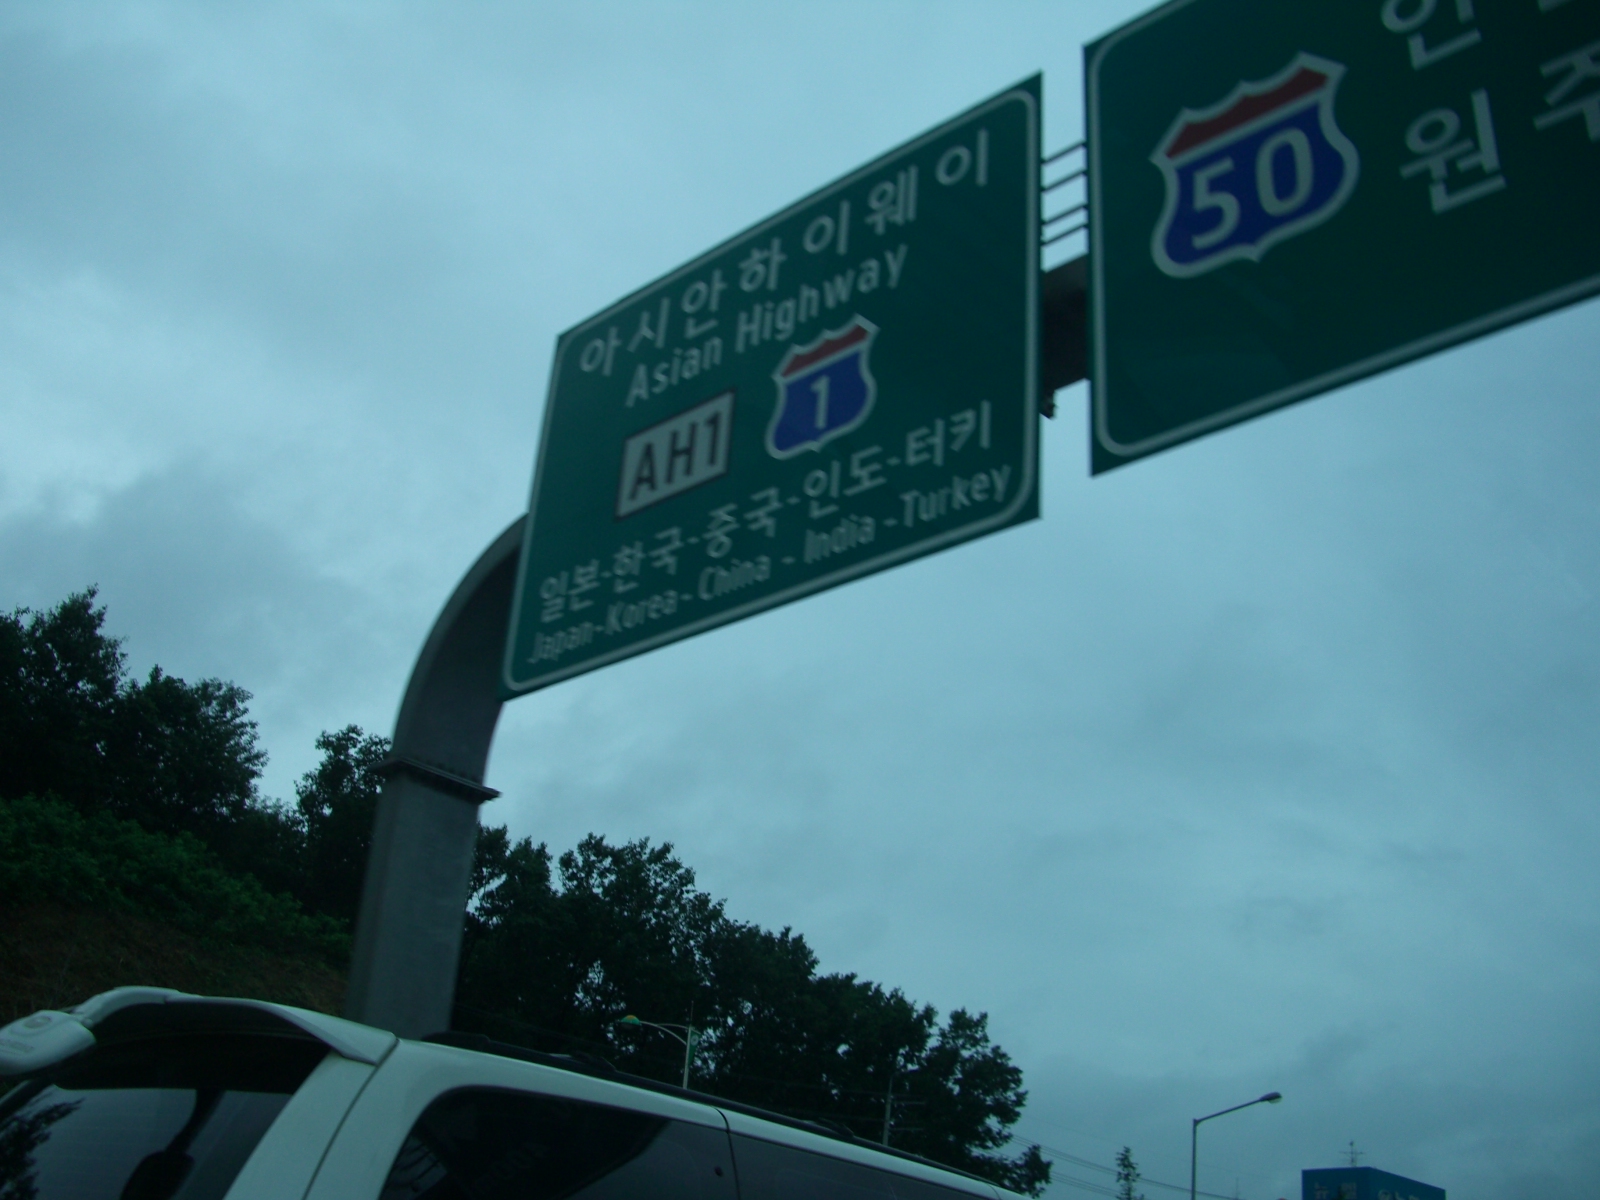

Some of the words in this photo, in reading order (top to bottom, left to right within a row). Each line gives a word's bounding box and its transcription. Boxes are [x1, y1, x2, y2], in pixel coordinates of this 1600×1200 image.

[1192, 127, 1315, 250] 50
[625, 336, 723, 407] Asian
[735, 243, 908, 353] Highway
[810, 374, 831, 430] 1
[630, 411, 722, 501] AH1
[697, 555, 772, 601] China
[803, 512, 877, 564] India
